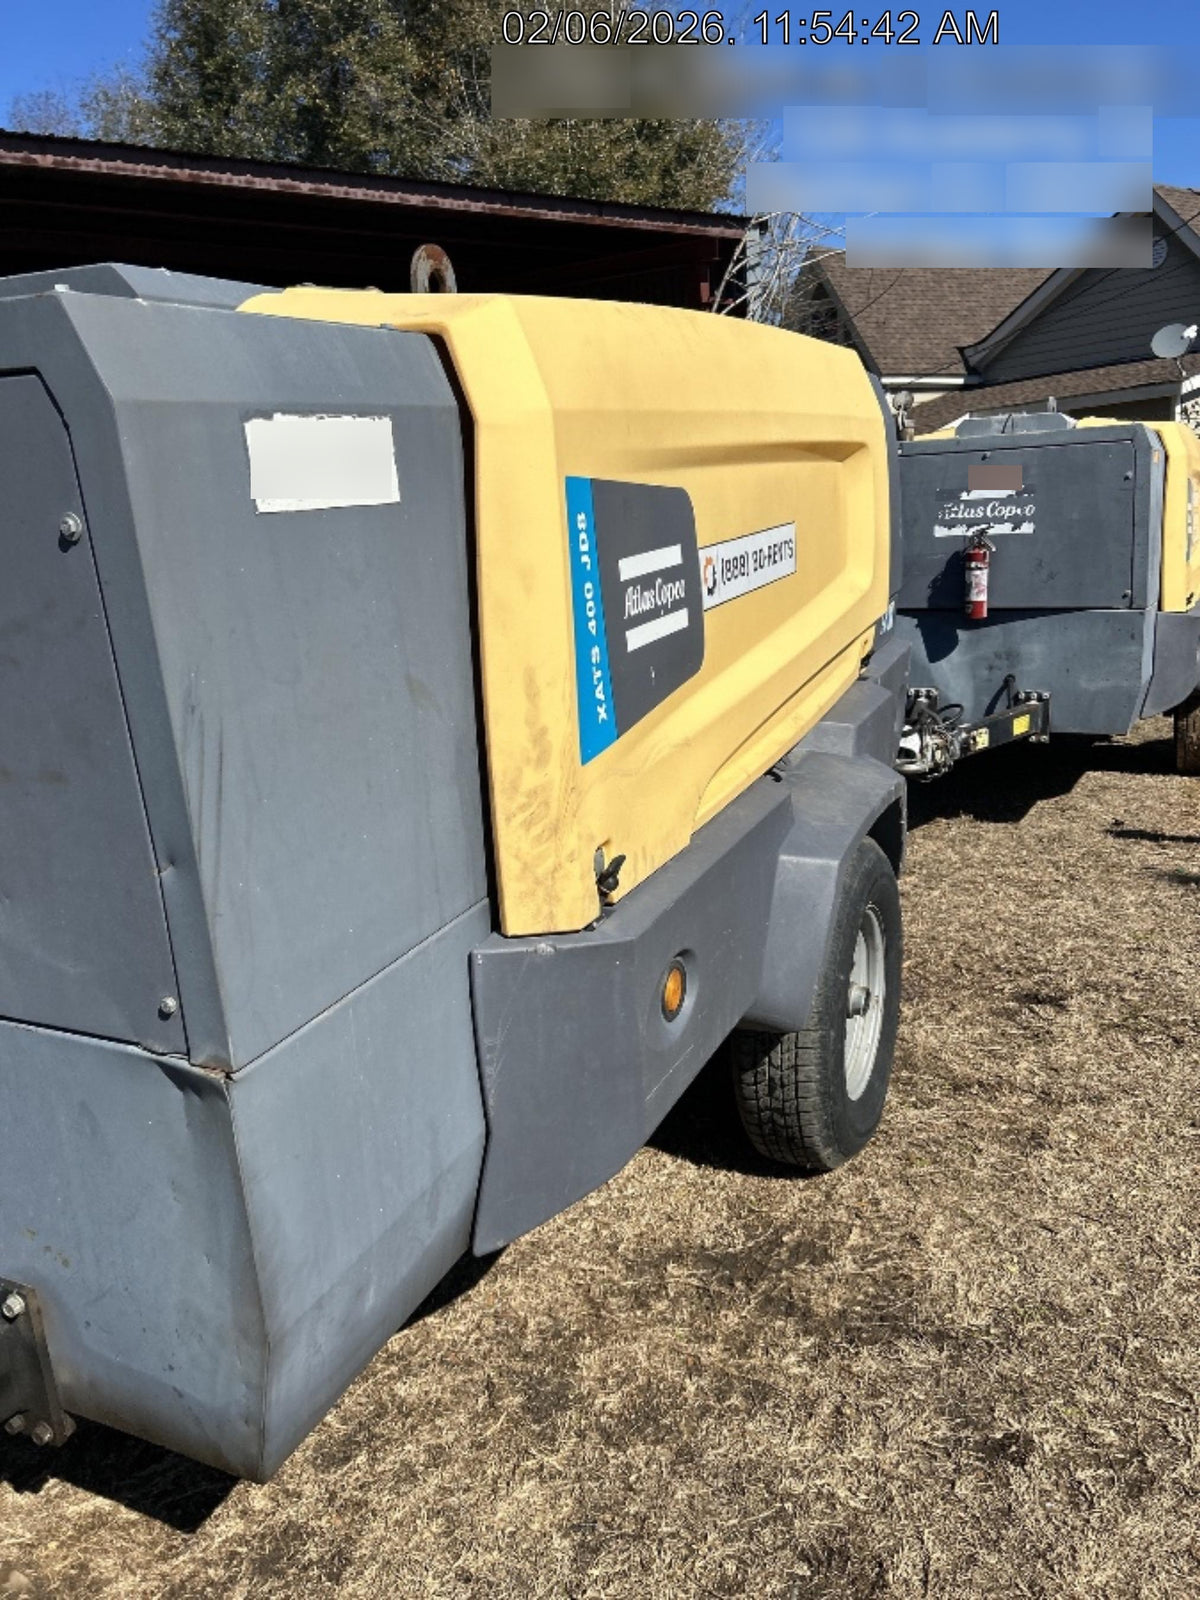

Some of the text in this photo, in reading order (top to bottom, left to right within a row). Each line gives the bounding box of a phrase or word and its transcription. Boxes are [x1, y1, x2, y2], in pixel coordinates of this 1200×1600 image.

[721, 550, 749, 586] (888)
[584, 581, 597, 636] 400
[623, 577, 686, 620] Atlas Copco
[591, 645, 608, 723] XATS
